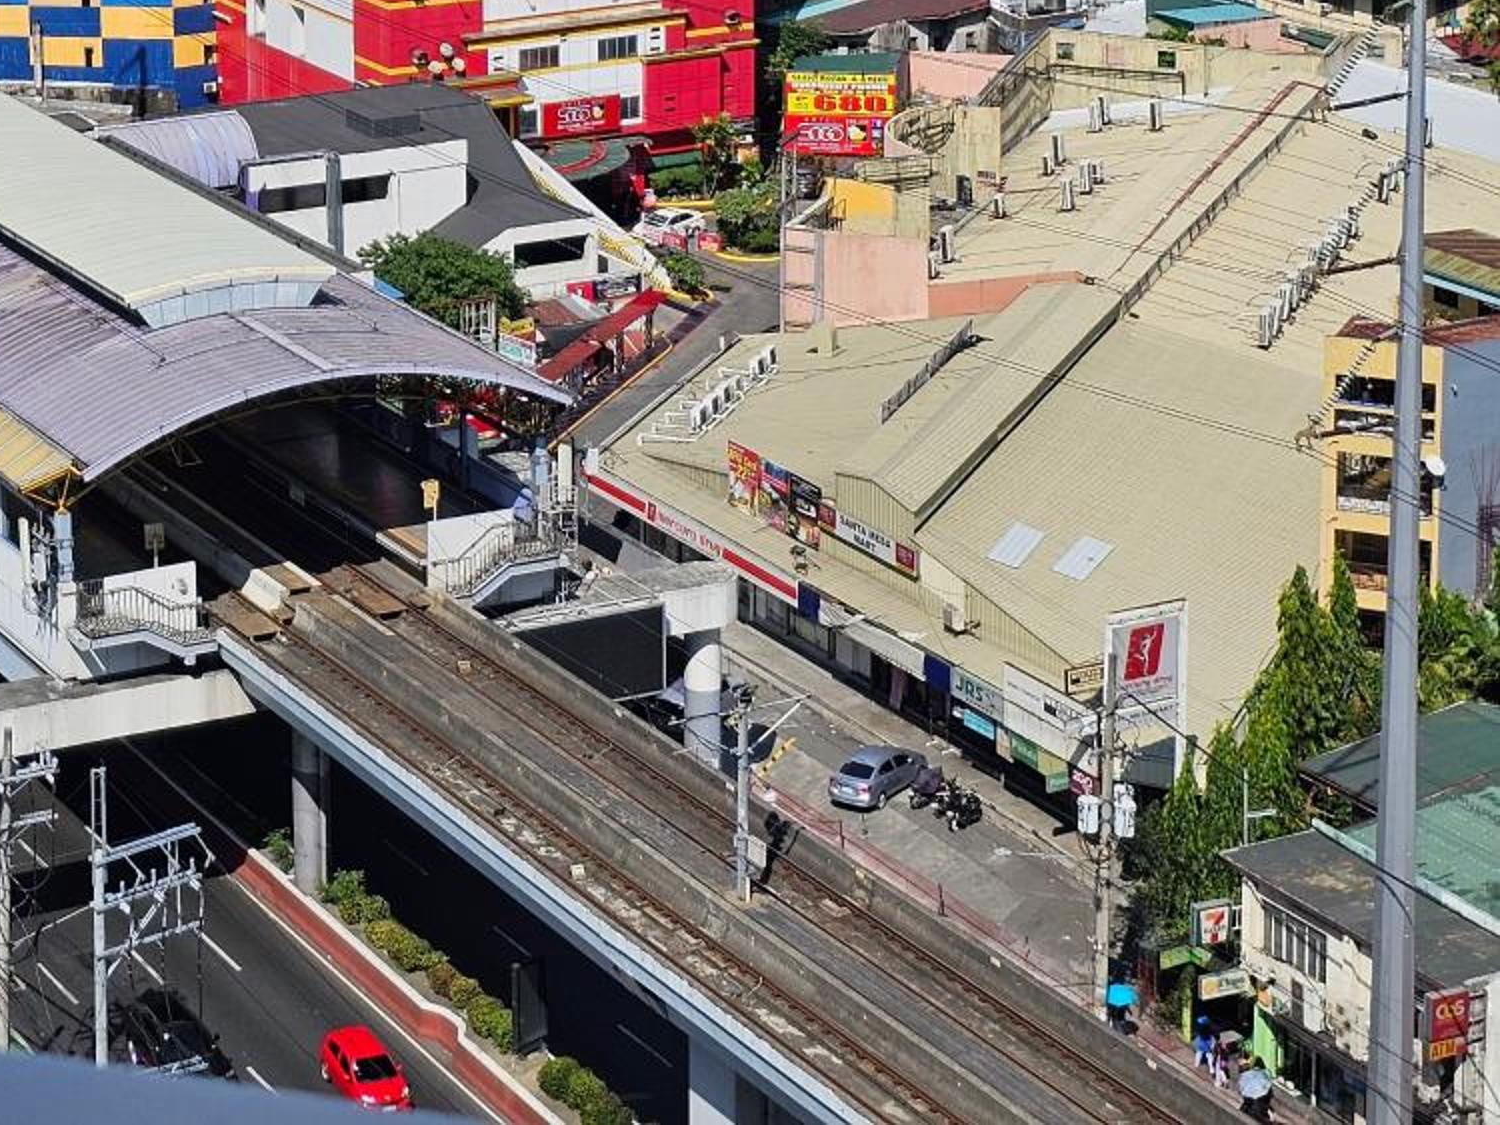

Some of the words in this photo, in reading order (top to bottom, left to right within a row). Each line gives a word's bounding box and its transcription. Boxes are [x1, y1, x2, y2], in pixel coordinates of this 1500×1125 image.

[797, 122, 845, 143] SOGO
[839, 514, 868, 538] SANTA
[955, 677, 984, 703] JRS
